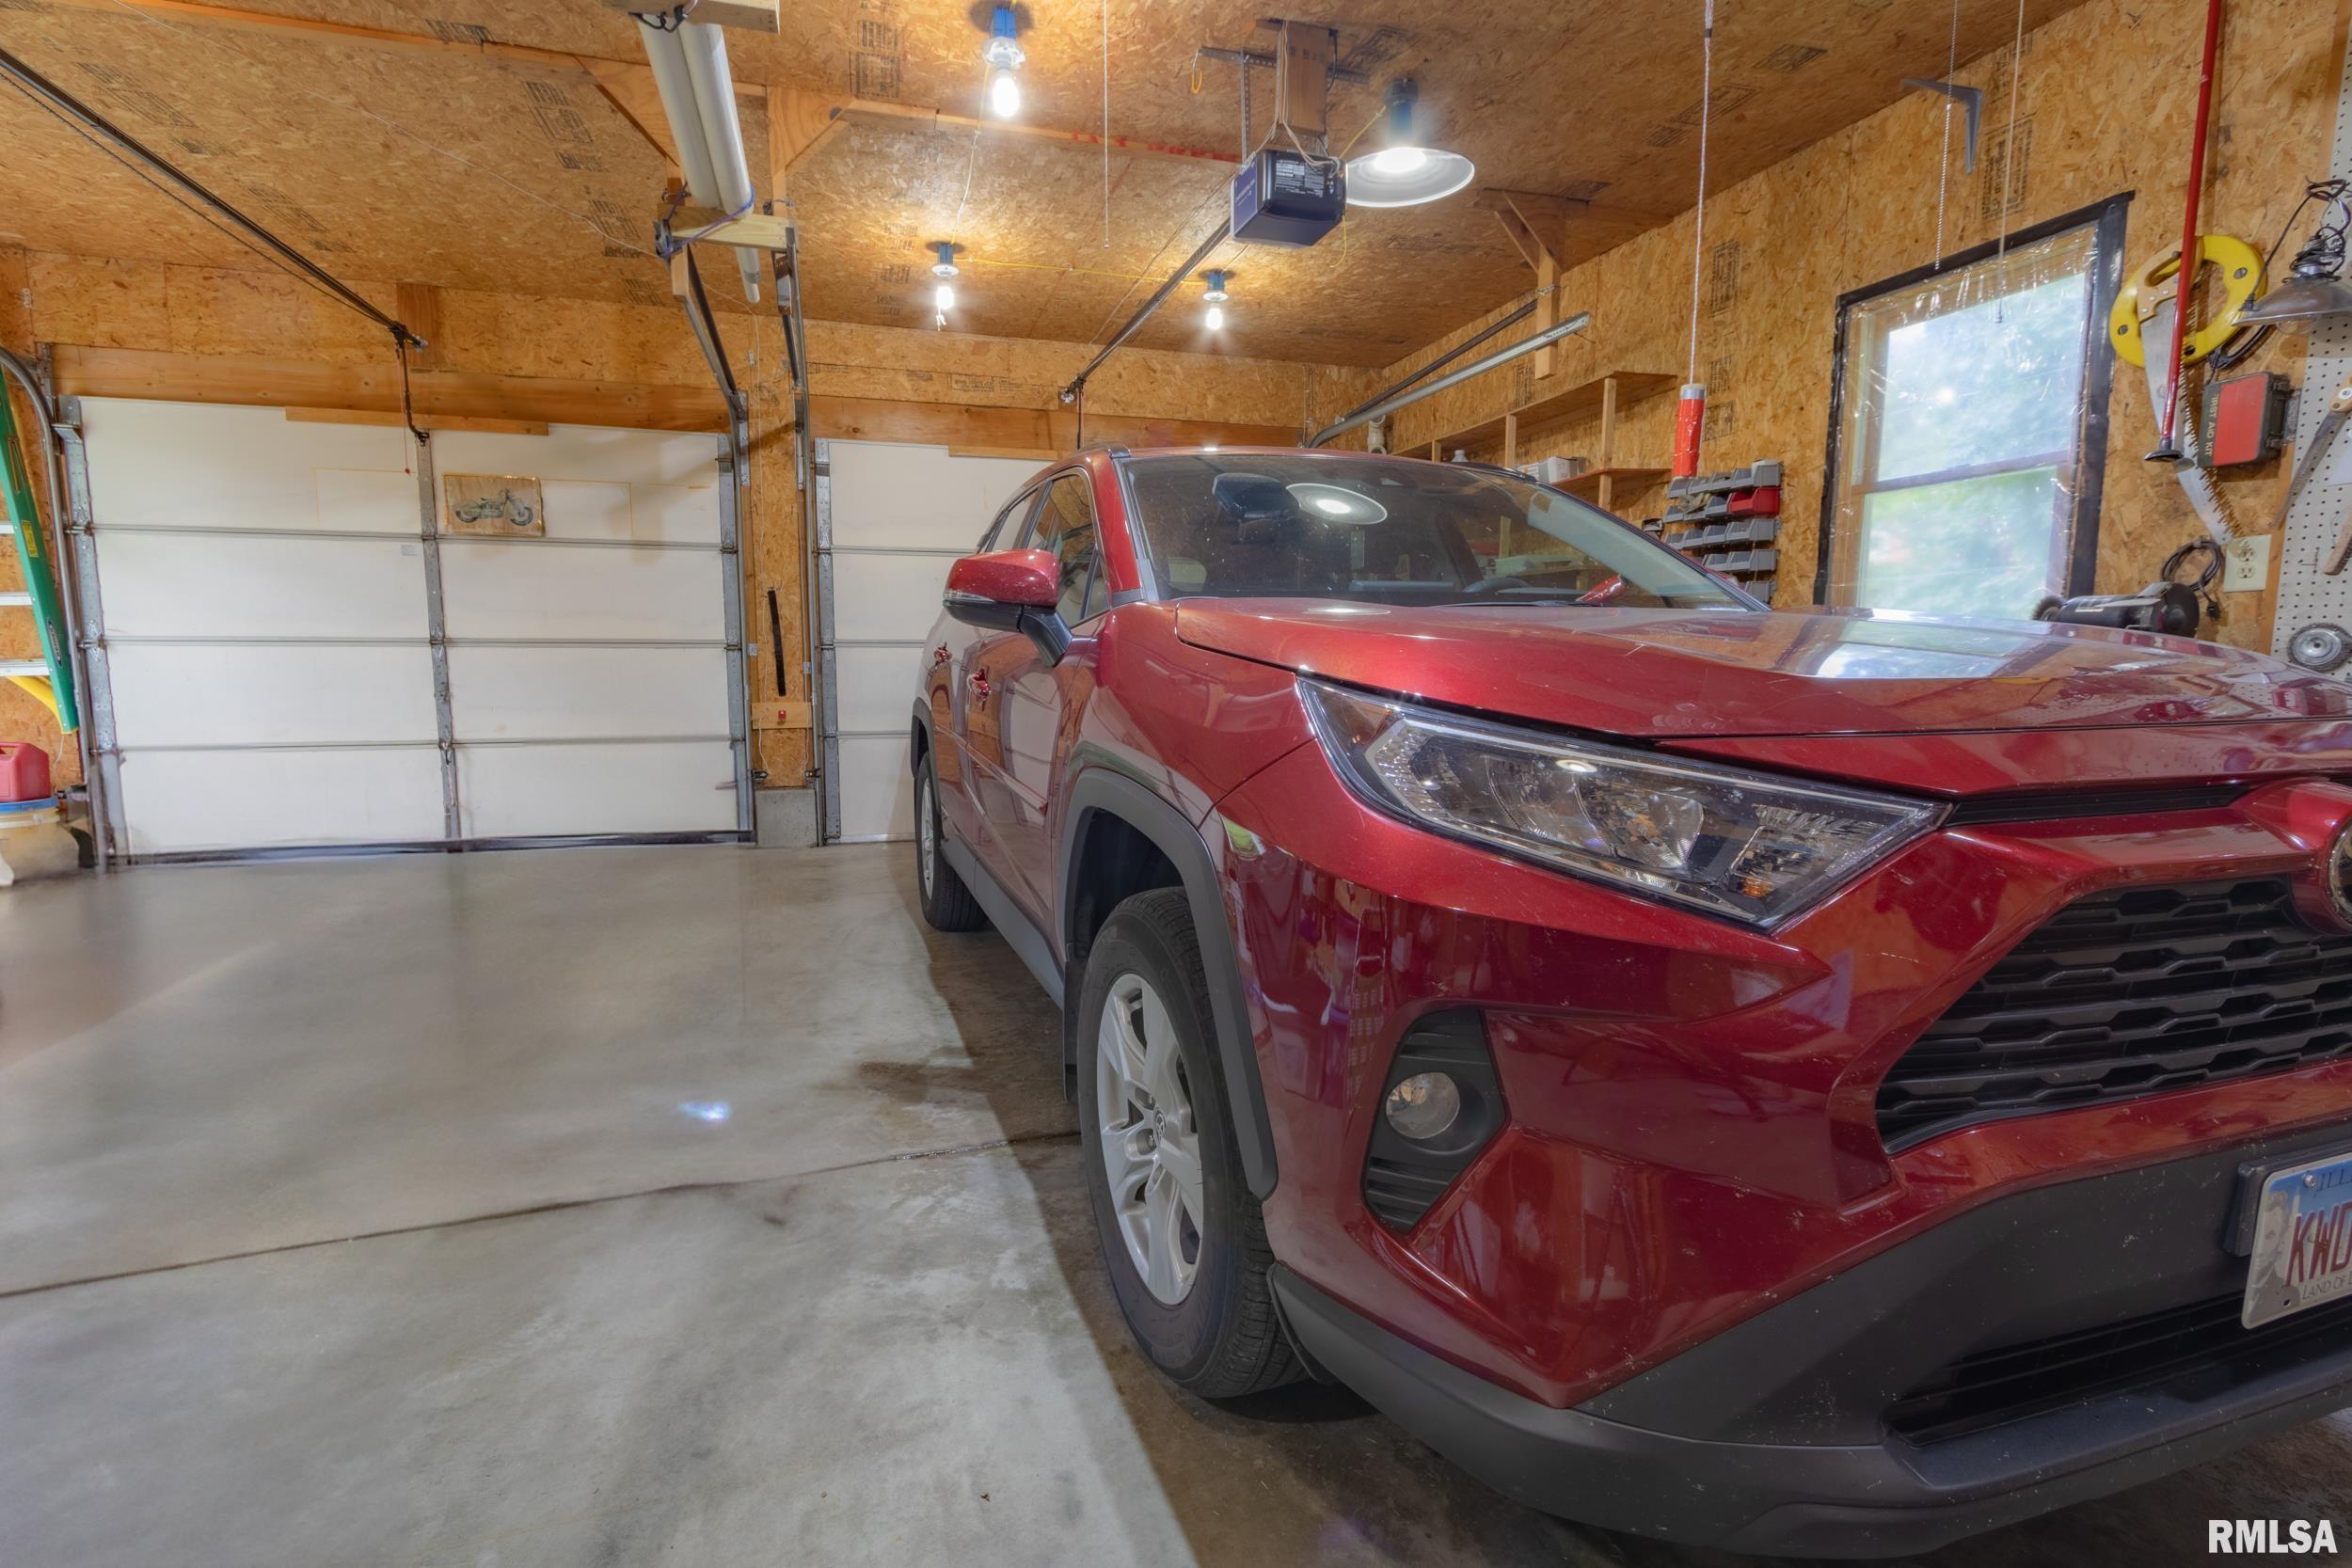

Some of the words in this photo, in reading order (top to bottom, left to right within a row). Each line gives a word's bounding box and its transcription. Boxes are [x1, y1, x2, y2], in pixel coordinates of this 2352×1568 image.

[2206, 422, 2216, 439] AID
[2204, 442, 2214, 457] KIT
[2285, 1200, 2352, 1287] KWD
[2302, 1279, 2332, 1300] LAND
[2333, 1275, 2346, 1291] OF
